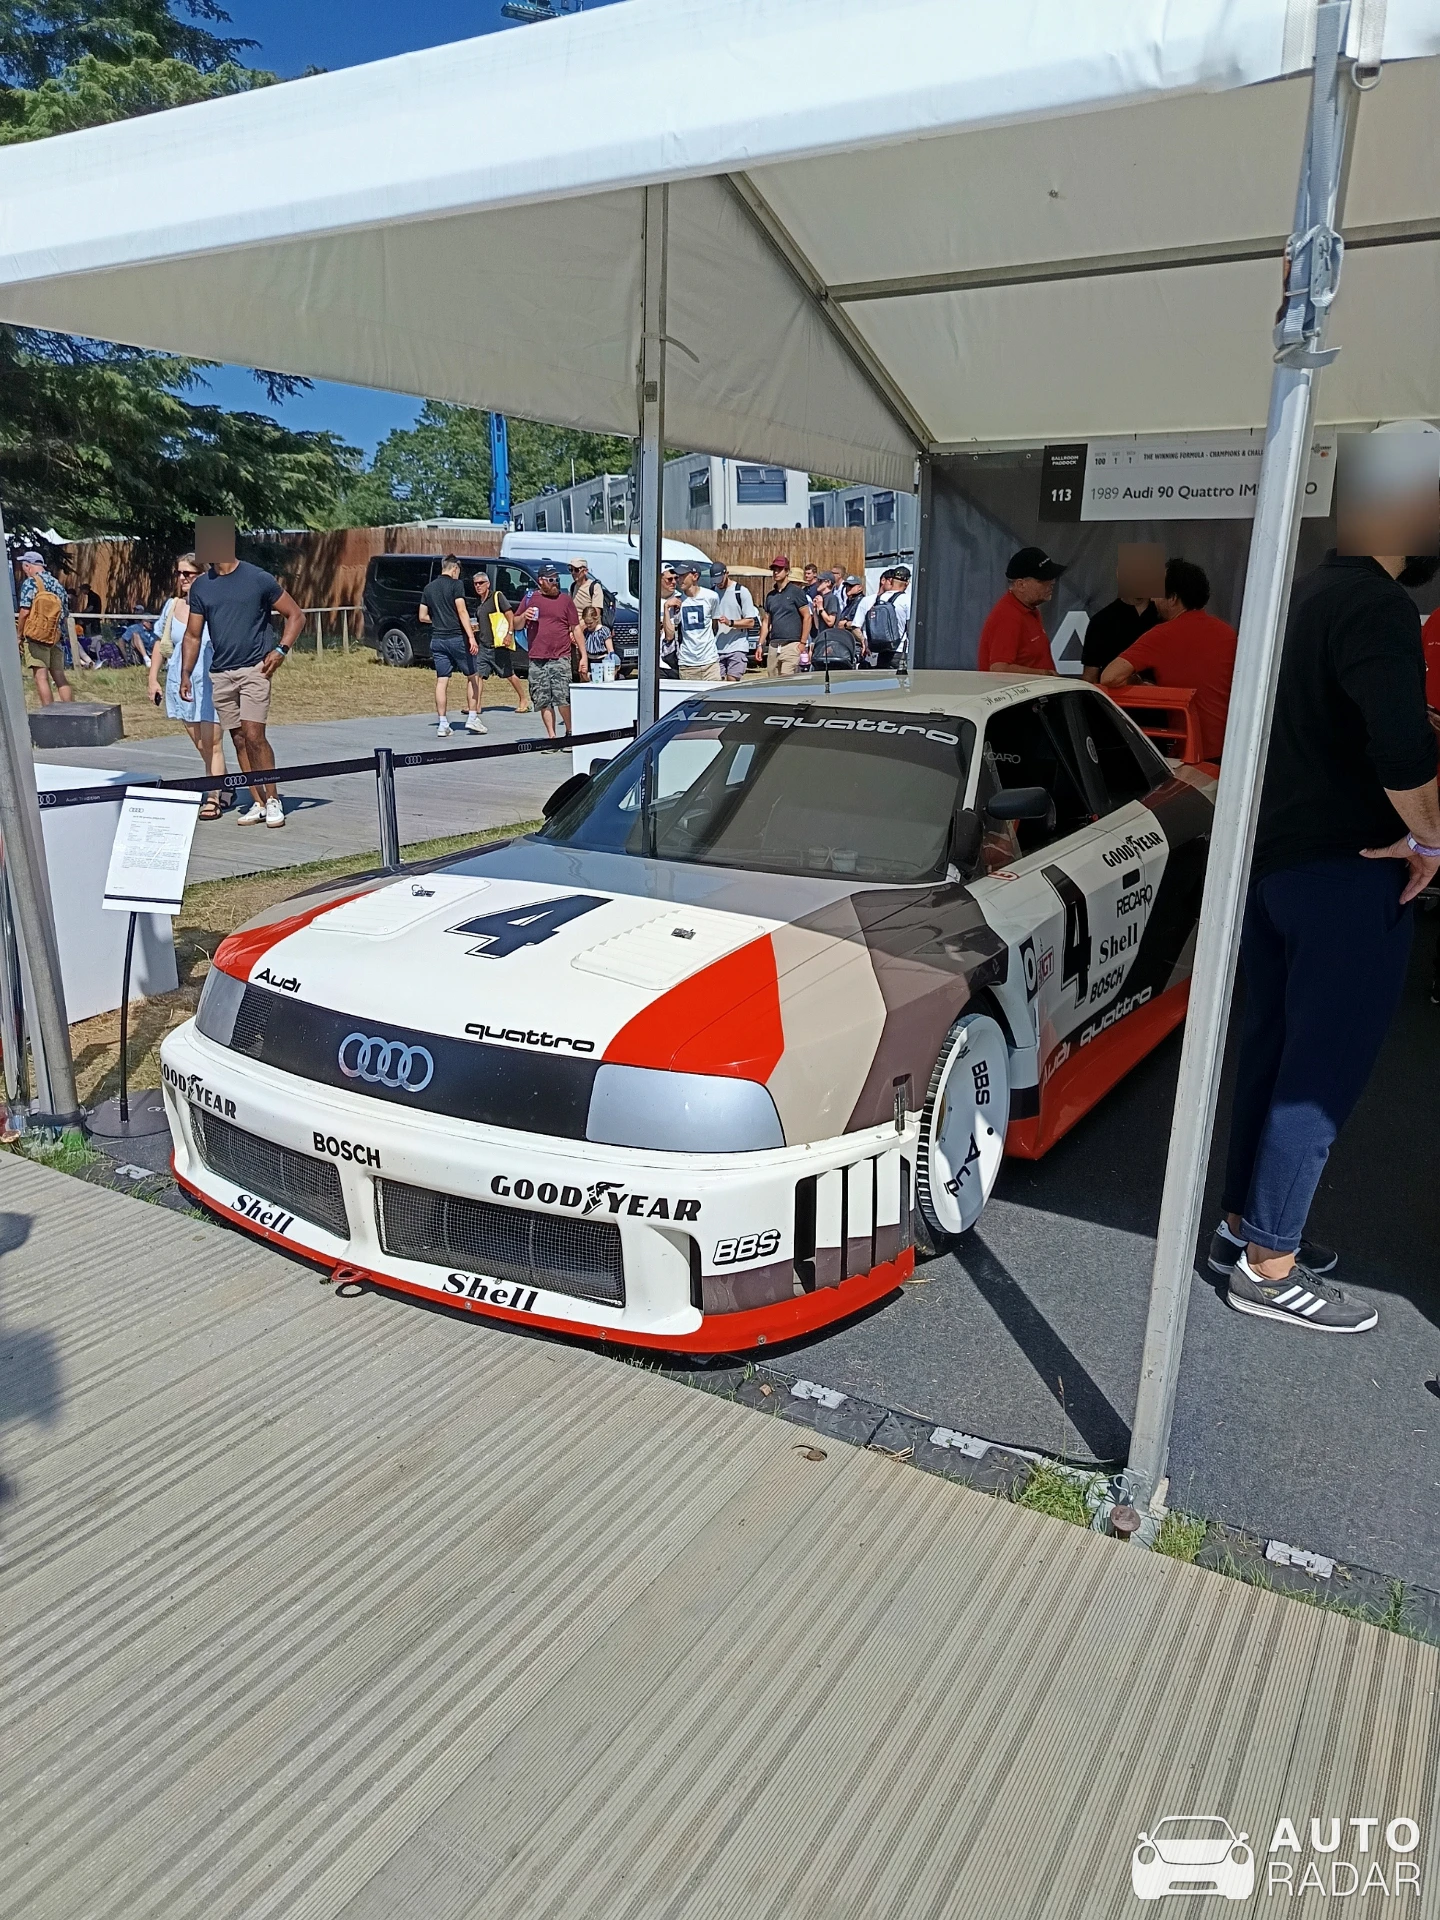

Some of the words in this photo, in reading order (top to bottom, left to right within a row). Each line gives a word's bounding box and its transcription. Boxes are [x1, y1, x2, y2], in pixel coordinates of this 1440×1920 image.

[1094, 457, 1107, 466] 100
[1155, 452, 1179, 460] WINNING
[1180, 451, 1205, 459] FORMULA
[1210, 449, 1241, 458] CHAMPIONS
[1051, 488, 1072, 502] 113
[1091, 487, 1119, 500] 1989
[1122, 486, 1154, 499] Audi
[1158, 486, 1174, 499] 90
[1178, 483, 1234, 499] Quattro
[1239, 483, 1263, 497] IM
[669, 709, 751, 724] Audi
[763, 714, 960, 746] quattro
[1116, 884, 1153, 918] RECARO
[443, 894, 614, 960] 4
[1041, 863, 1092, 1009] 4
[1099, 922, 1139, 966] Shell
[255, 968, 302, 993] Audi
[1090, 965, 1125, 1004] BOSCH
[1080, 985, 1153, 1048] quattro
[464, 1022, 595, 1053] quattro
[971, 1060, 990, 1106] BBS
[312, 1131, 381, 1169] BOSCH
[230, 1194, 295, 1235] Shell
[713, 1229, 780, 1266] BBS
[441, 1272, 539, 1312] Shell
